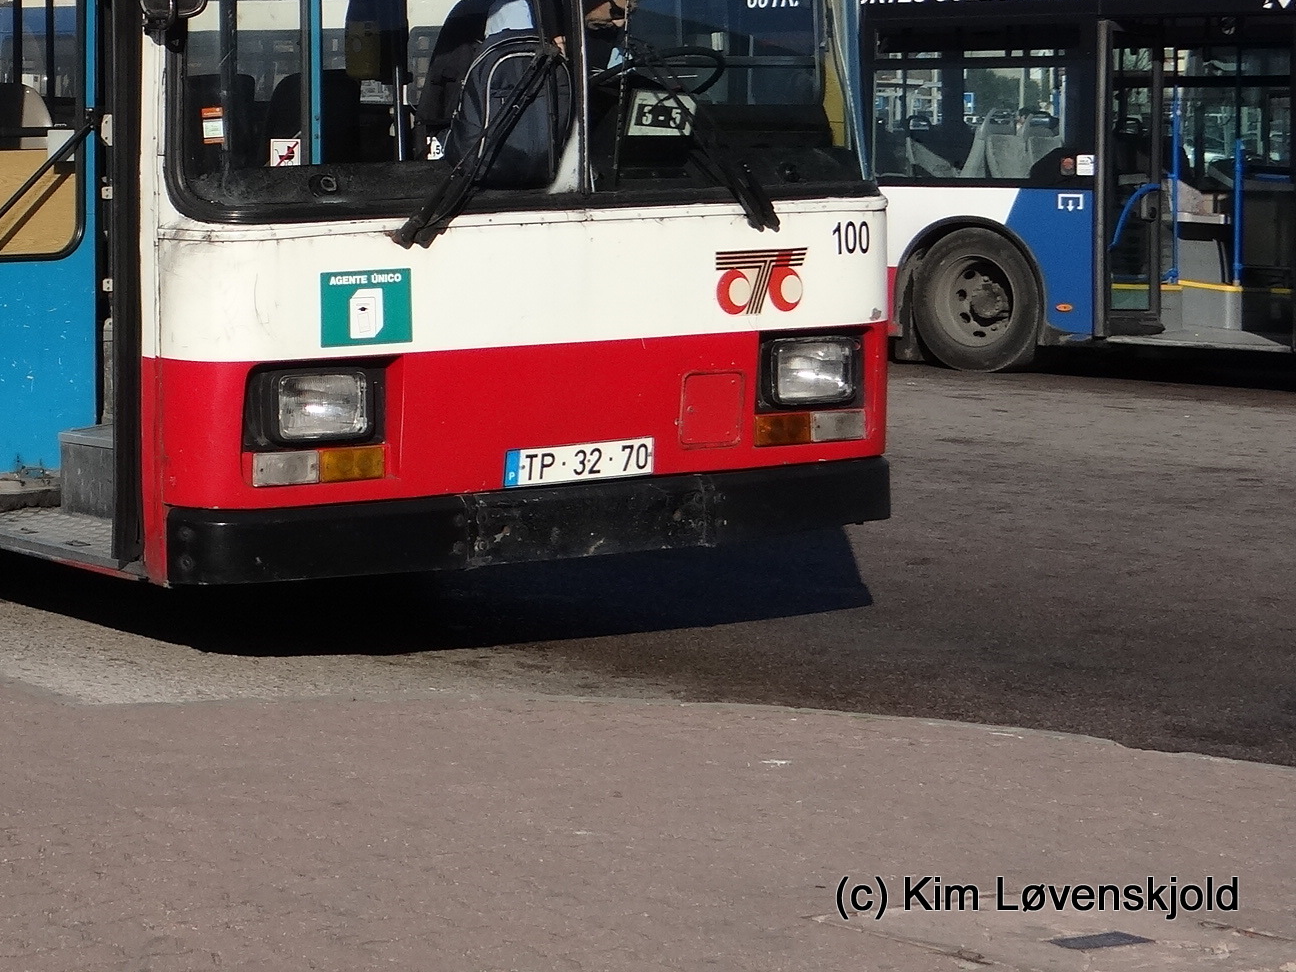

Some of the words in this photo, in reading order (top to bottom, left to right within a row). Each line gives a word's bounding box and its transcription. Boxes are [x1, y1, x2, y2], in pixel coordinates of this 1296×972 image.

[832, 221, 870, 255] 100
[329, 275, 368, 285] AGENTE
[371, 273, 402, 284] ÚNICO
[508, 471, 515, 480] P
